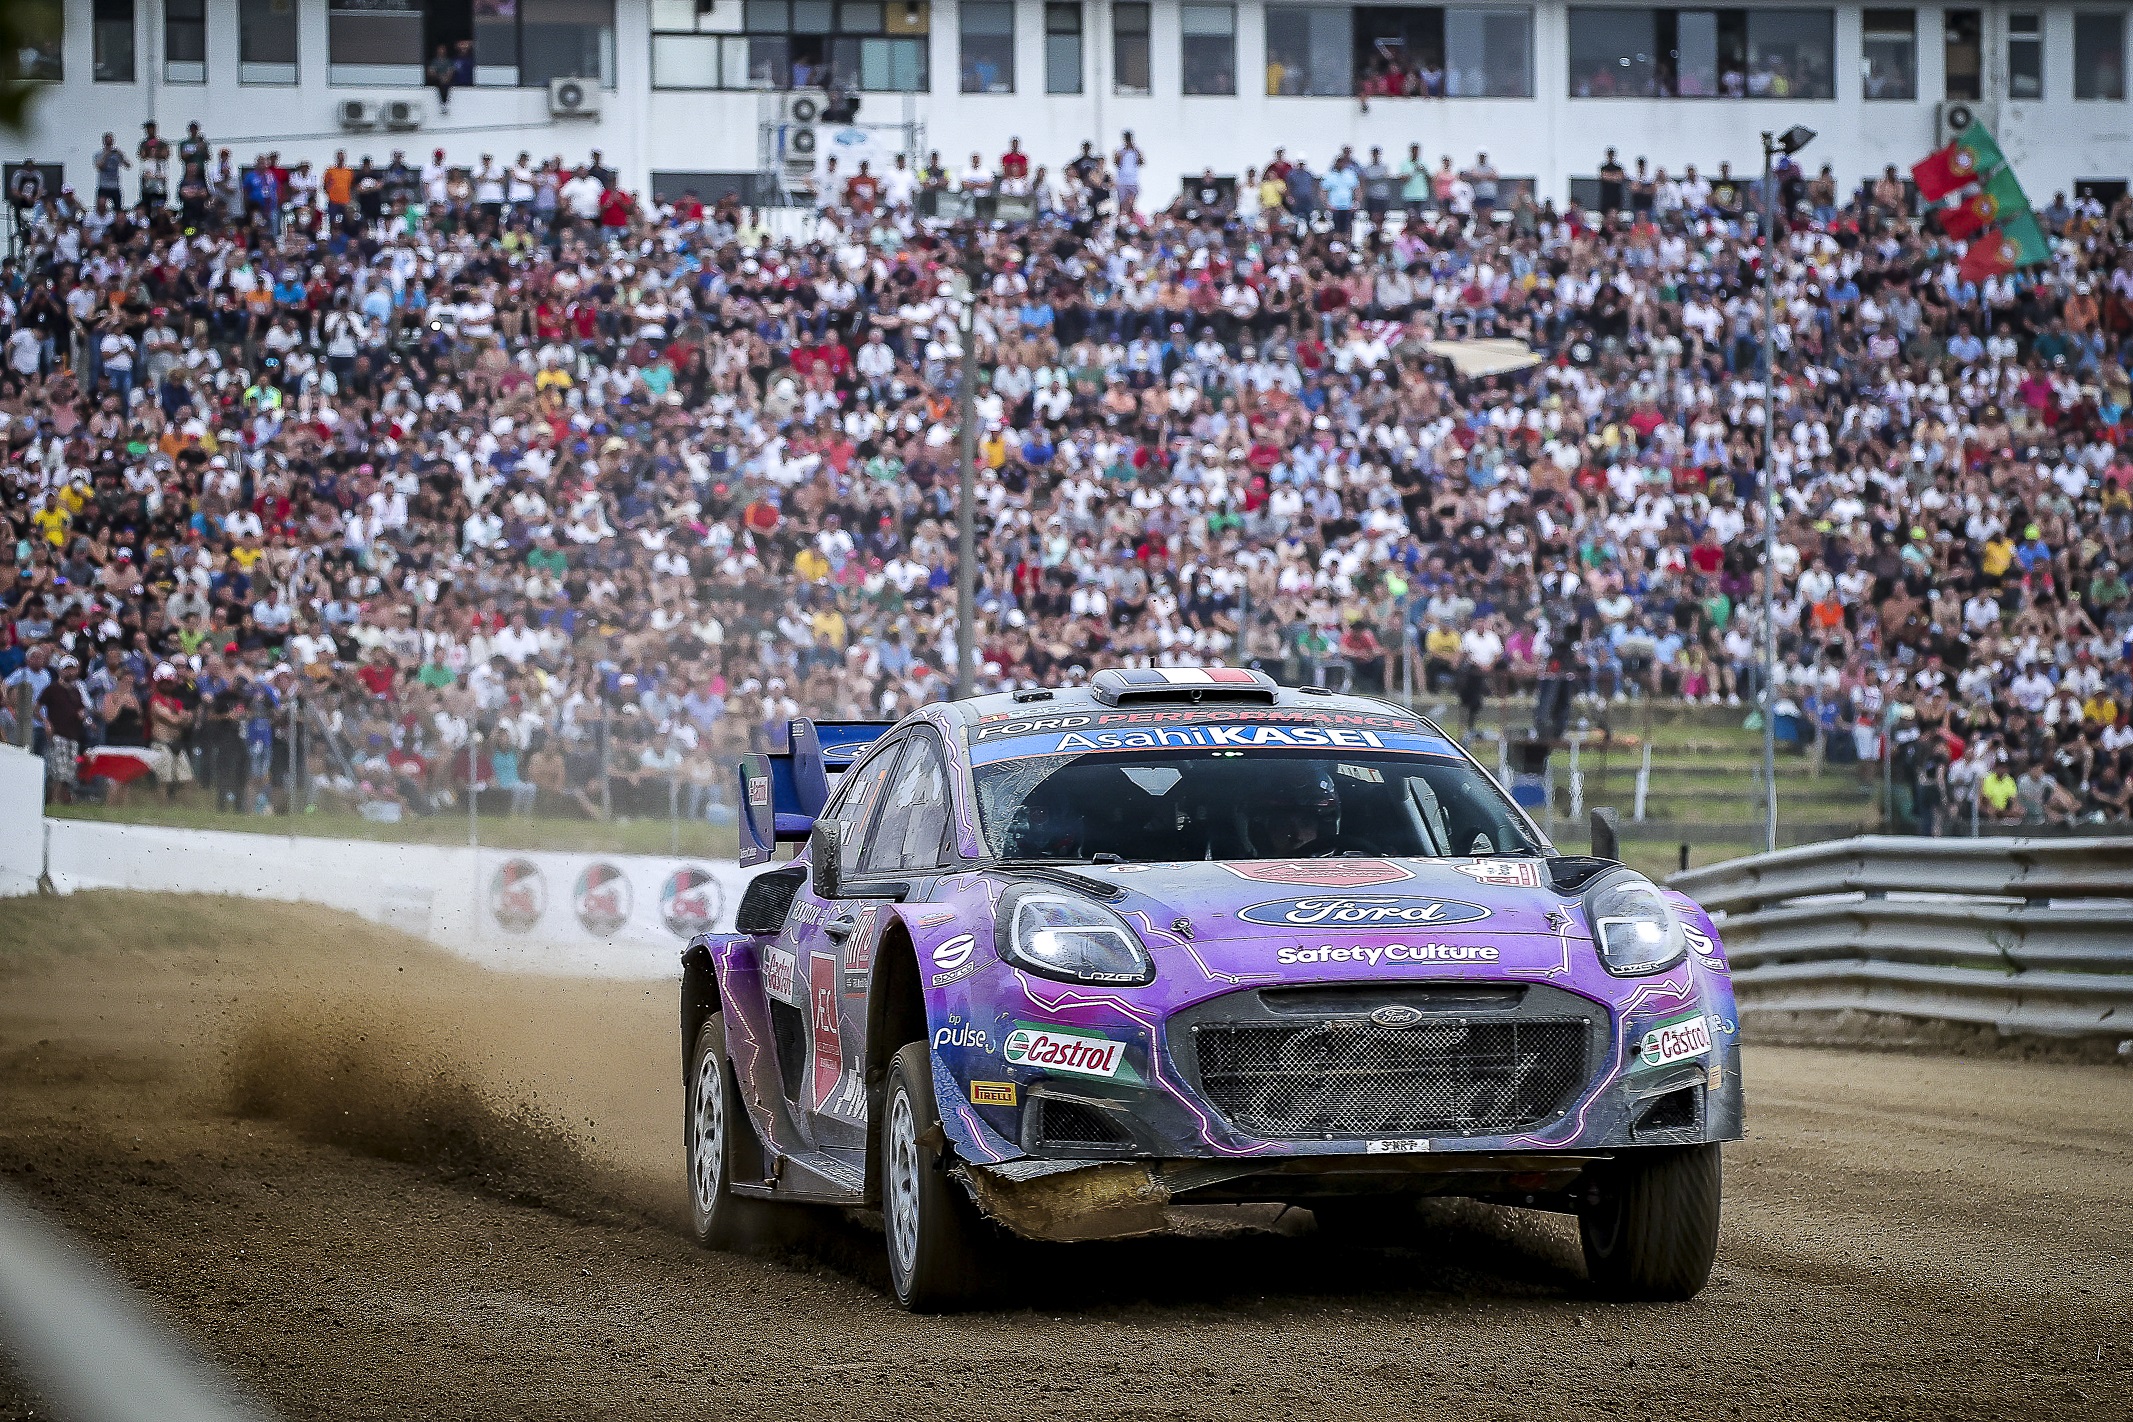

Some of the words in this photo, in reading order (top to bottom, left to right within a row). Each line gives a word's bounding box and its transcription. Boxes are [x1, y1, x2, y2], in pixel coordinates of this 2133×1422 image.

[977, 716, 1091, 739] FORD
[1098, 711, 1416, 730] PERFORMANCE
[1055, 726, 1385, 751] AsahiKASEI
[1284, 898, 1447, 923] Ford
[1277, 943, 1499, 966] SafetyCulture
[949, 1013, 961, 1025] bp
[1381, 1008, 1412, 1024] Ford
[933, 1023, 987, 1050] pulse
[1027, 1035, 1116, 1072] Castrol
[974, 1084, 1013, 1102] PIRELLI
